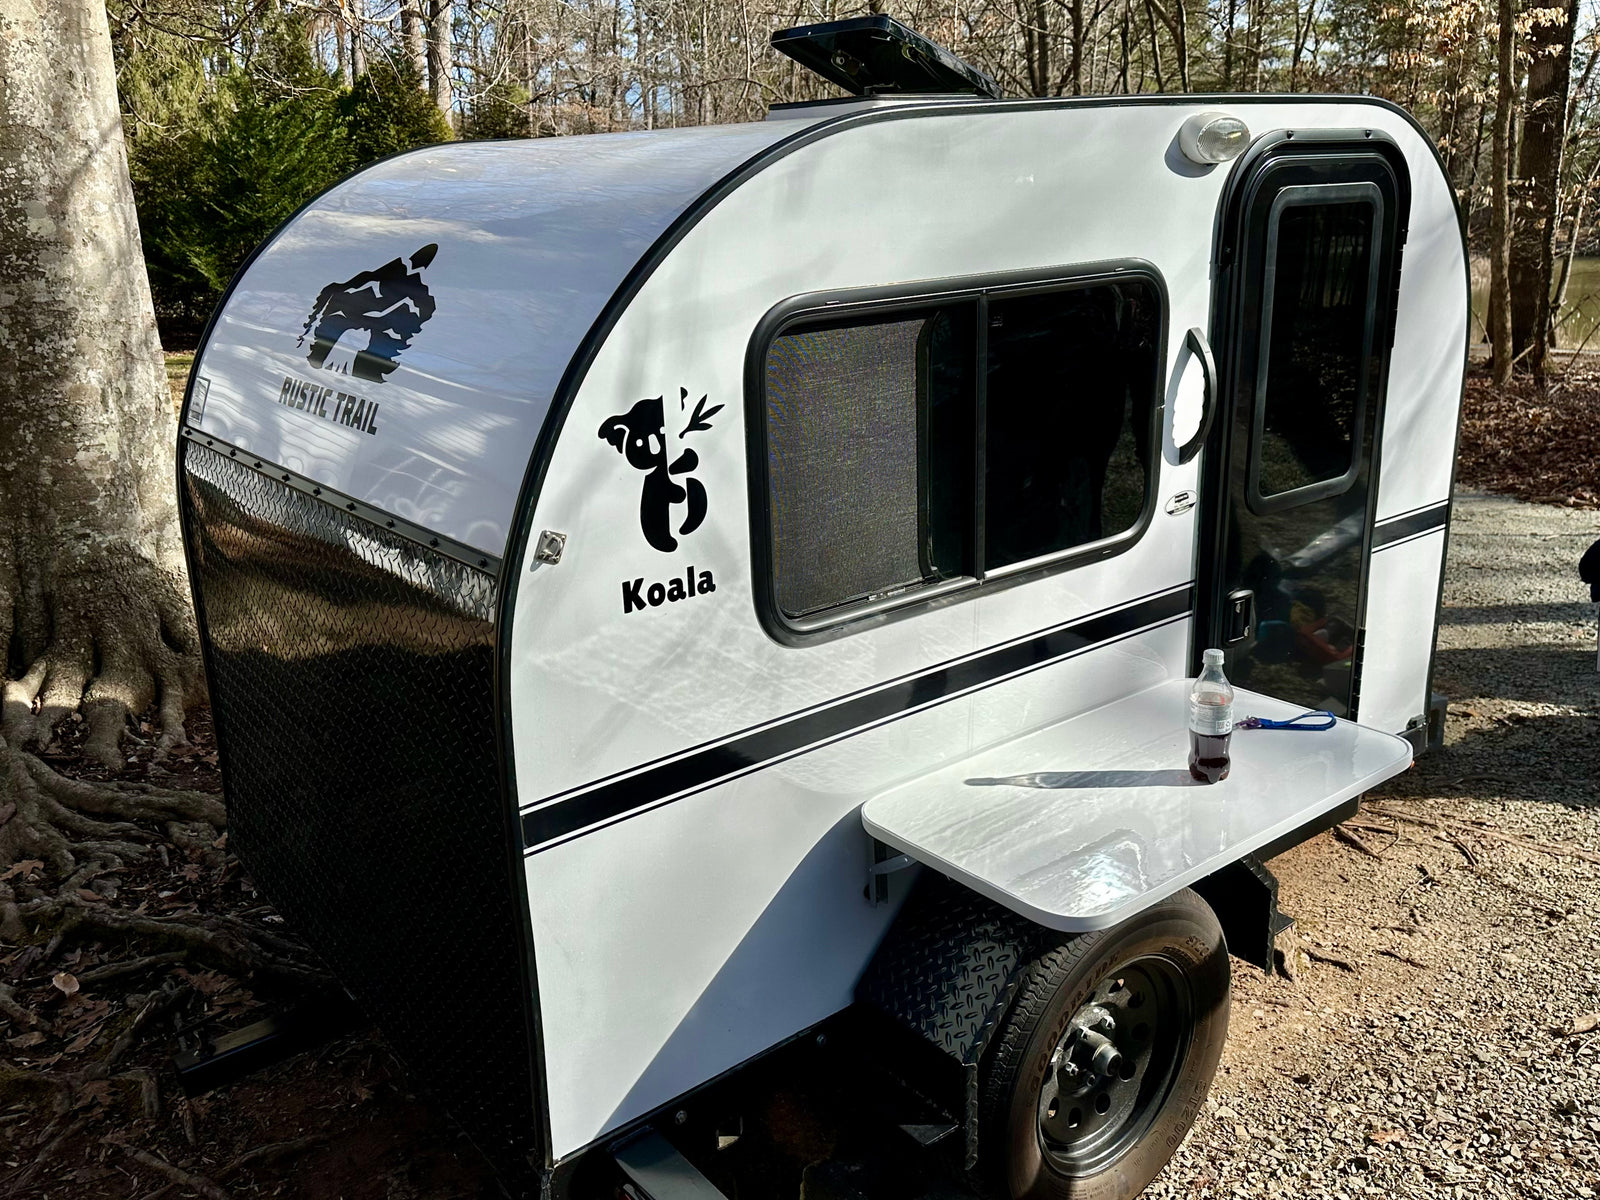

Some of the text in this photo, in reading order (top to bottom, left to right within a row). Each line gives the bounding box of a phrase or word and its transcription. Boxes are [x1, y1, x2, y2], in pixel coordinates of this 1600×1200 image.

[279, 376, 379, 435] RUSTIC TRAIL
[621, 565, 717, 614] Koala
